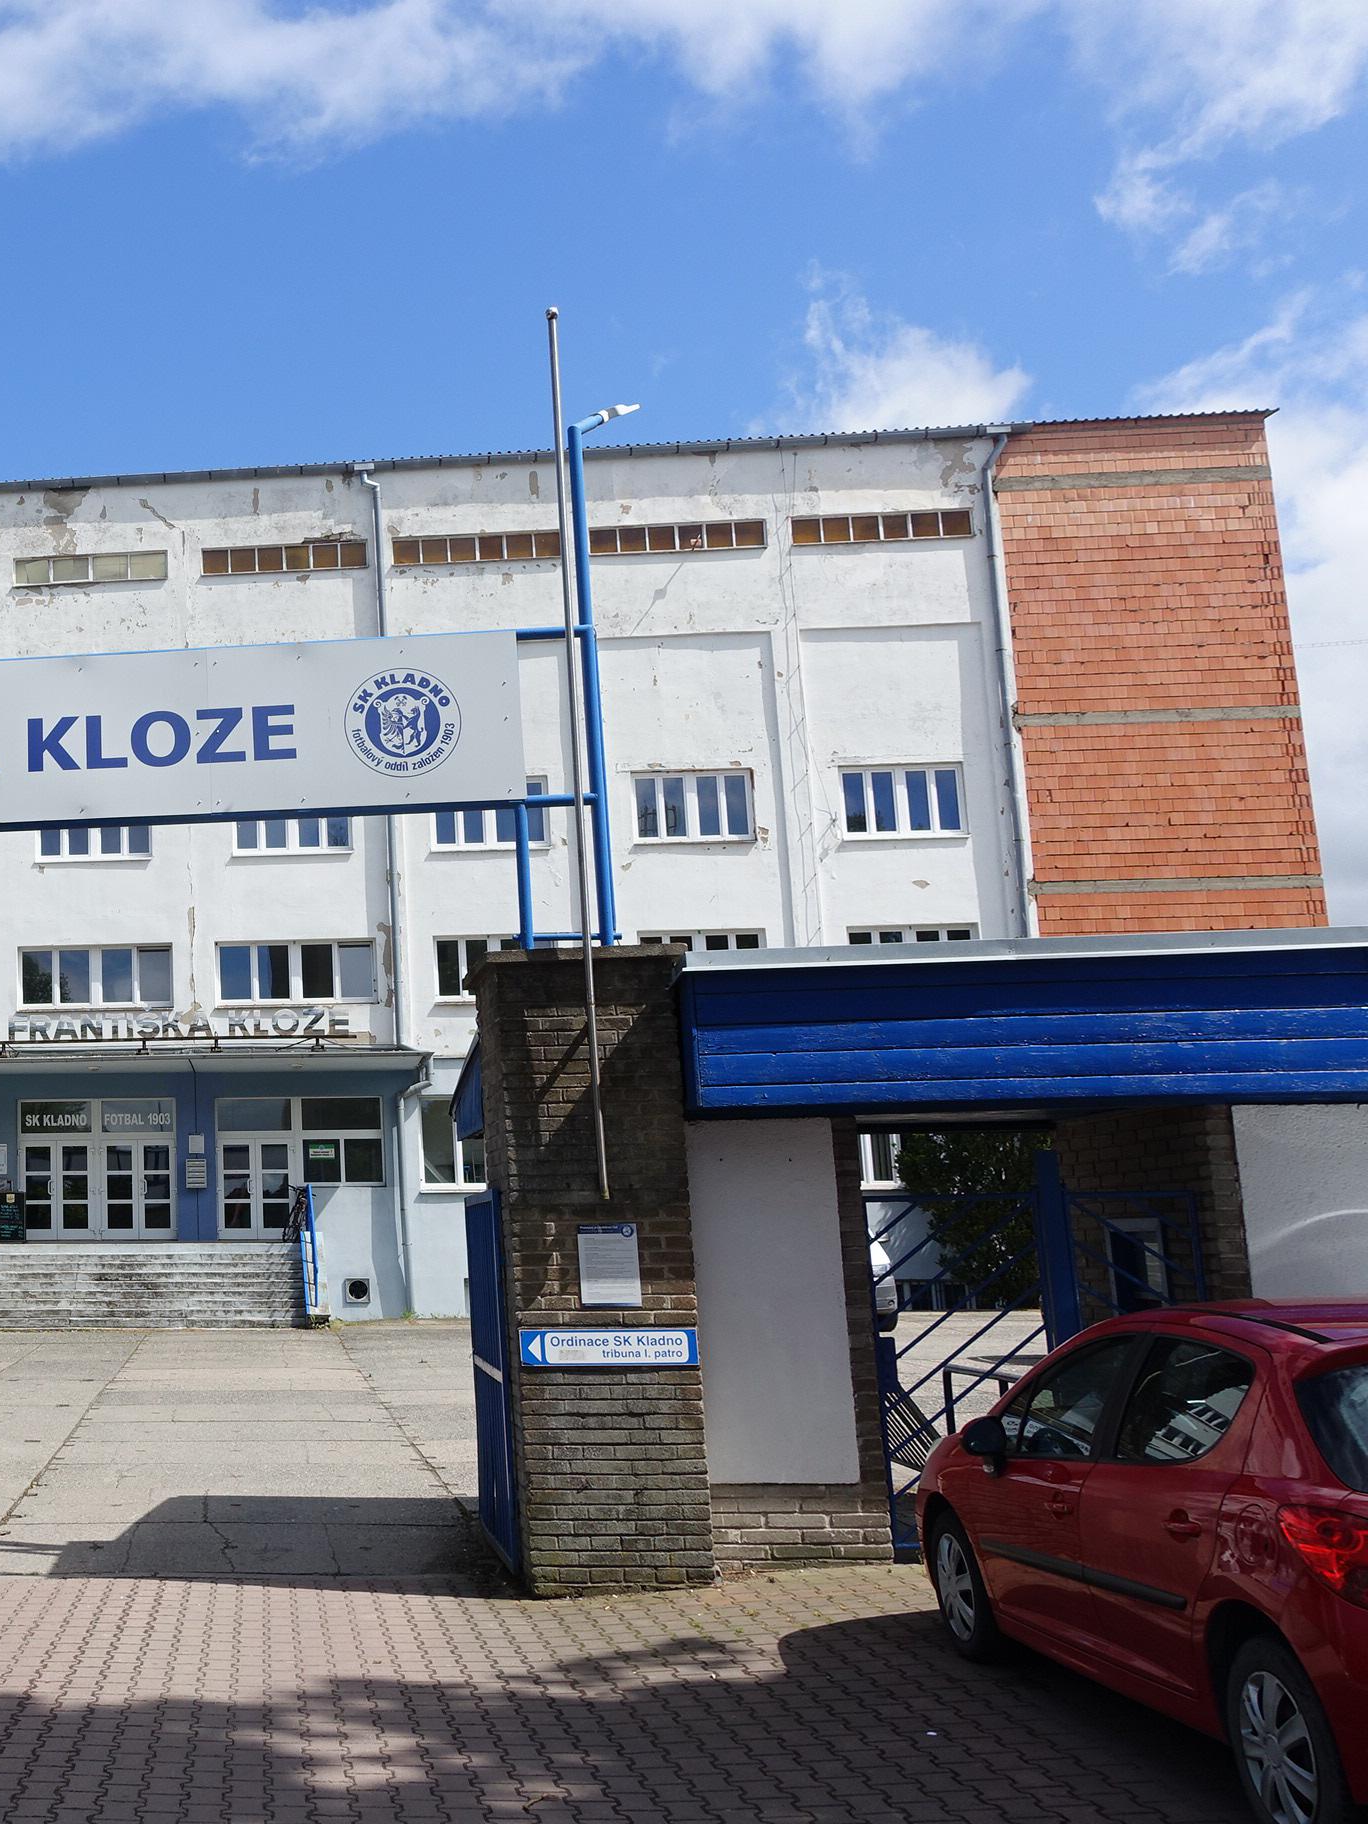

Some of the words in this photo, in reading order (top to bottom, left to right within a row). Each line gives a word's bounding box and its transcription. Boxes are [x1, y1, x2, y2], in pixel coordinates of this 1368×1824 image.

[353, 689, 374, 714] SK
[374, 673, 450, 707] KLADNO
[28, 704, 298, 772] KLOZE
[352, 728, 384, 767] fotbalový
[412, 747, 445, 770] založen
[441, 722, 455, 745] 1903
[9, 1004, 215, 1041] FRANTIŠKA
[228, 1007, 350, 1036] KLOZE
[25, 1114, 40, 1127] SK
[43, 1113, 87, 1127] KLADNO
[104, 1112, 145, 1125] FOTBAL
[147, 1112, 171, 1125] 1903
[550, 1336, 609, 1347] Ordinace
[613, 1335, 632, 1346] SK
[637, 1335, 683, 1346] Kladno
[602, 1349, 641, 1359] tribuna
[654, 1350, 683, 1360] patro
